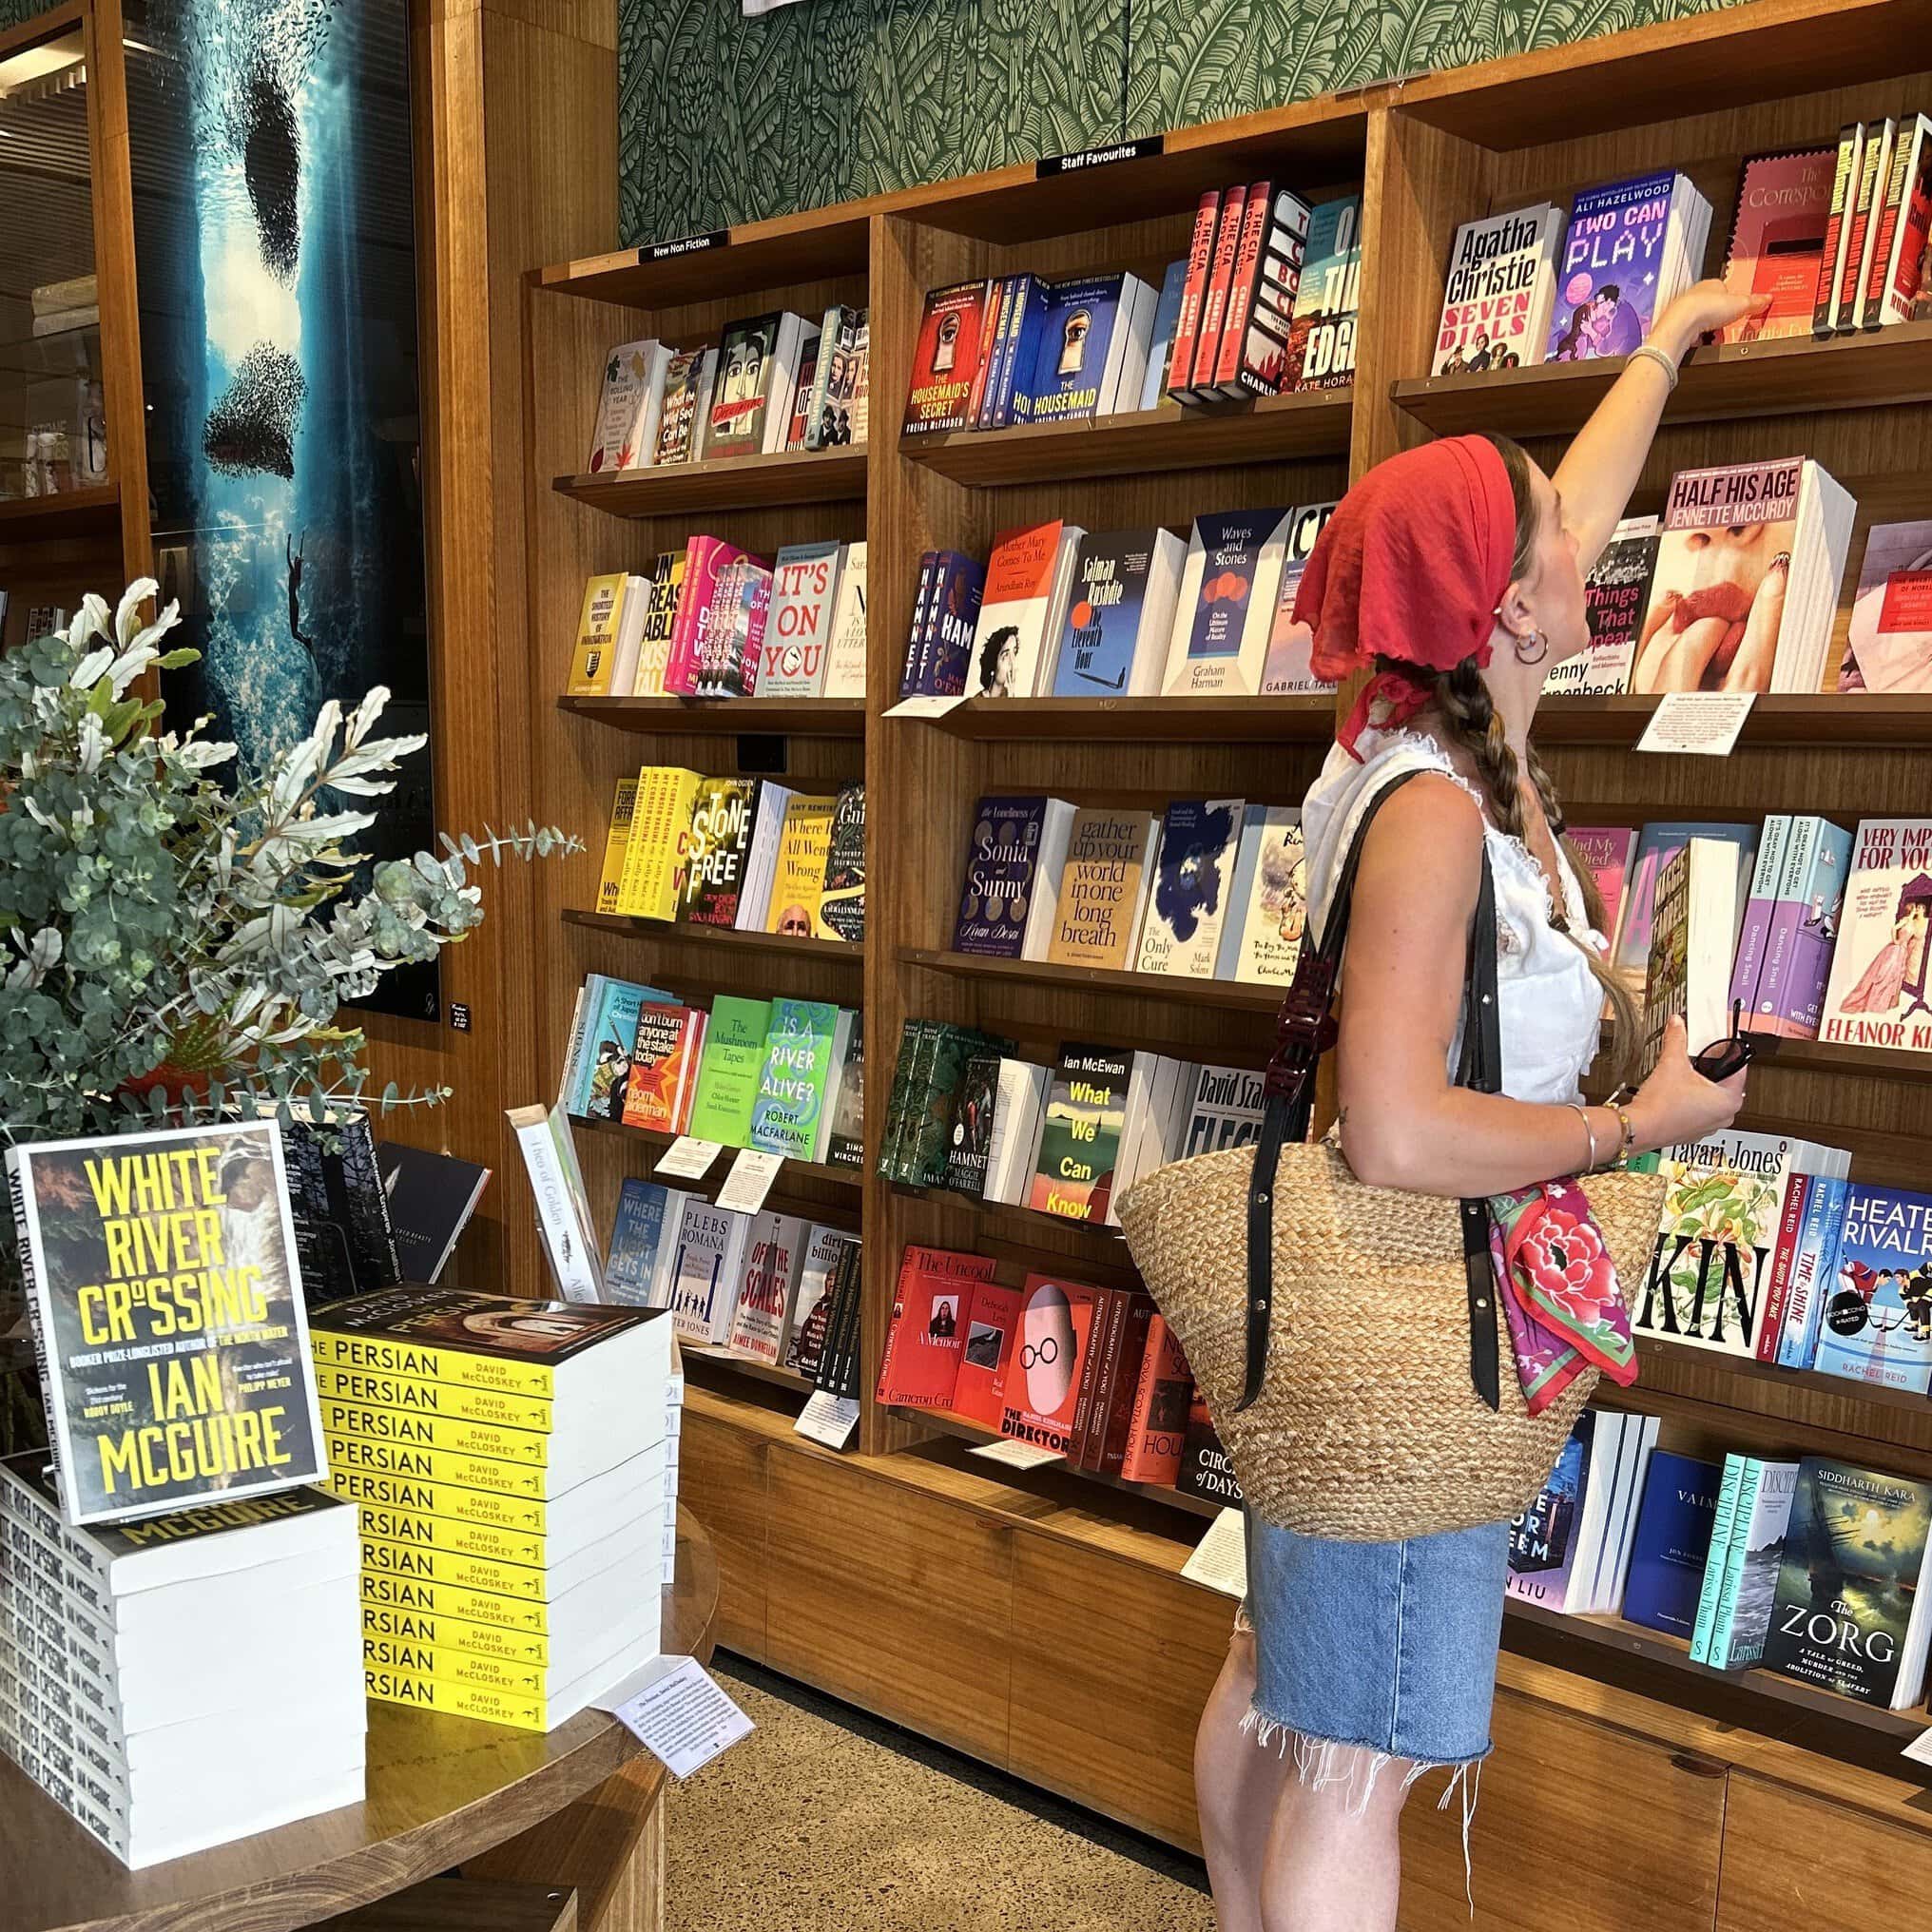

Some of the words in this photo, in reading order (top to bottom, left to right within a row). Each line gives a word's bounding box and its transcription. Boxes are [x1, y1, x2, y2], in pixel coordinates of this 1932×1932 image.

[1061, 155, 1084, 170] Staff
[1086, 145, 1136, 166] Favourites
[1575, 200, 1594, 214] ALI
[1597, 184, 1671, 209] HAZELWOOD
[1575, 213, 1615, 240] TWO
[1624, 200, 1667, 226] CAN
[654, 246, 668, 258] New
[671, 243, 685, 256] Non
[686, 237, 710, 251] Fiction
[1459, 217, 1538, 273] Agatha
[1566, 222, 1663, 274] PLAY
[1447, 253, 1536, 305] Christie
[1444, 290, 1531, 329] SEVEN
[1439, 315, 1527, 351] DIALS
[935, 374, 949, 383] THE
[1295, 382, 1323, 393] KATE
[1323, 375, 1354, 389] HORA
[911, 381, 970, 405] HOUSEMAID'S
[1034, 388, 1097, 415] HOUSEMAID
[920, 399, 955, 420] SECRET
[1671, 477, 1724, 508] HALF
[1725, 473, 1760, 505] HIS
[1760, 467, 1799, 499] AGE
[1670, 503, 1736, 529] JENNETTE
[1731, 497, 1794, 524] MCCURDY
[1222, 527, 1252, 541] Waves
[1225, 539, 1243, 552] and
[996, 553, 1020, 569] Comes
[1022, 551, 1032, 564] To
[1034, 550, 1046, 562] Me
[1081, 555, 1116, 583] Salman
[1215, 552, 1248, 567] Stones
[778, 562, 829, 597] IT'S
[1089, 579, 1124, 607] Rushdie
[1585, 585, 1639, 609] Things
[777, 604, 821, 637] ON
[1597, 609, 1635, 630] That
[1072, 627, 1103, 648] Eleventh
[764, 645, 822, 678] YOU
[1074, 648, 1093, 670] Hour
[1191, 678, 1224, 689] Harman
[1193, 666, 1226, 678] Graham
[689, 792, 751, 861] STONE
[1080, 818, 1138, 841] gather
[1861, 828, 1899, 847] VERY
[1902, 828, 1932, 847] IMP
[784, 840, 800, 856] All
[978, 836, 1030, 864] Sonia
[1072, 838, 1096, 862] up
[1093, 842, 1139, 864] your
[686, 850, 739, 904] FREE
[786, 860, 821, 884] Wrong
[1078, 859, 1128, 883] world
[970, 871, 1025, 904] Sunny
[1073, 903, 1113, 930] long
[958, 923, 990, 942] Kiran
[991, 925, 1020, 941] Desai
[1060, 919, 1117, 948] breath
[1747, 924, 1761, 963] Dancing
[1145, 938, 1173, 958] Only
[1193, 953, 1211, 964] Mark
[1773, 927, 1787, 966] Dancing
[1141, 956, 1169, 973] Cure
[1741, 962, 1751, 986] Snail
[1768, 964, 1779, 989] Snail
[638, 1026, 669, 1040] anyone
[668, 1030, 679, 1042] at
[641, 1014, 662, 1026] don't
[662, 1015, 684, 1029] burn
[782, 1016, 798, 1035] IS
[802, 1019, 814, 1039] A
[636, 1037, 651, 1049] the
[650, 1039, 675, 1054] stake
[713, 1031, 759, 1051] Mushroom
[635, 1049, 657, 1067] today
[722, 1048, 745, 1065] Tapes
[769, 1046, 815, 1071] RIVER
[1064, 1055, 1080, 1071] Ian
[1081, 1057, 1126, 1075] McEwan
[628, 1089, 655, 1104] naomi
[760, 1077, 815, 1102] ALIVE?
[1070, 1080, 1111, 1107] What
[626, 1100, 668, 1117] alderman
[764, 1110, 800, 1125] ROBERT
[750, 1125, 811, 1146] MACFARLANE
[1072, 1120, 1095, 1143] We
[948, 1150, 988, 1169] HAMNET
[1059, 1156, 1092, 1181] Can
[1729, 1141, 1785, 1175] Jones
[84, 1147, 227, 1218] WHITE
[954, 1168, 979, 1181] MAGGIE
[624, 1197, 662, 1224] WHERE
[1046, 1192, 1092, 1219] Know
[685, 1211, 728, 1236] PLEBS
[103, 1209, 226, 1279] RIVER
[618, 1236, 650, 1260] LIGHT
[681, 1228, 724, 1252] ROMANA
[609, 1253, 638, 1275] GETS
[639, 1266, 652, 1282] IN
[917, 1251, 938, 1273] The
[942, 1254, 992, 1281] Uncool
[1798, 1252, 1816, 1284] TIME
[741, 1268, 785, 1319] SCALES
[1634, 1231, 1770, 1348] KIN
[1789, 1287, 1808, 1324] SHINE
[733, 1331, 751, 1350] AIMEE
[918, 1331, 925, 1347] A
[927, 1332, 962, 1350] Memoir
[462, 1372, 522, 1389] McCLOSKEY
[1140, 1353, 1150, 1384] NOVA
[1842, 1363, 1880, 1380] RACHEL
[1884, 1370, 1907, 1384] REID
[146, 1354, 227, 1422] IAN
[336, 1374, 438, 1410] PERSIAN
[474, 1397, 506, 1410] DAVID
[1004, 1406, 1021, 1422] THE
[1132, 1389, 1146, 1425] SCOTIA
[332, 1407, 435, 1443] PERSIAN
[471, 1431, 501, 1443] DAVID
[1001, 1419, 1071, 1454] DIRECTOR
[97, 1405, 291, 1495] MCGUIRE
[332, 1440, 433, 1477] PERSIAN
[1124, 1429, 1138, 1465] HOUSE
[469, 1464, 500, 1477] DAVID
[334, 1473, 435, 1510] PERSIAN
[1195, 1472, 1207, 1487] of
[1206, 1473, 1244, 1499] DAYS
[1818, 1468, 1883, 1497] SIDDHARTH
[1884, 1485, 1916, 1504] KARA
[1711, 1462, 1739, 1551] DISCIPLINE
[1730, 1467, 1759, 1556] DISCIPLINE
[120, 1494, 317, 1546] MCGUIRE
[1517, 1580, 1547, 1600] LIU
[1704, 1560, 1716, 1595] Larissa
[1724, 1565, 1735, 1602] Larissa
[1697, 1595, 1710, 1631] Pham
[1717, 1602, 1729, 1635] Pham
[1830, 1599, 1854, 1617] The
[1779, 1603, 1895, 1665] ZORG
[456, 1669, 514, 1688] McCLOSKEY
[456, 1701, 514, 1720] McCLOSKEY
[471, 1693, 500, 1706] DAVID
